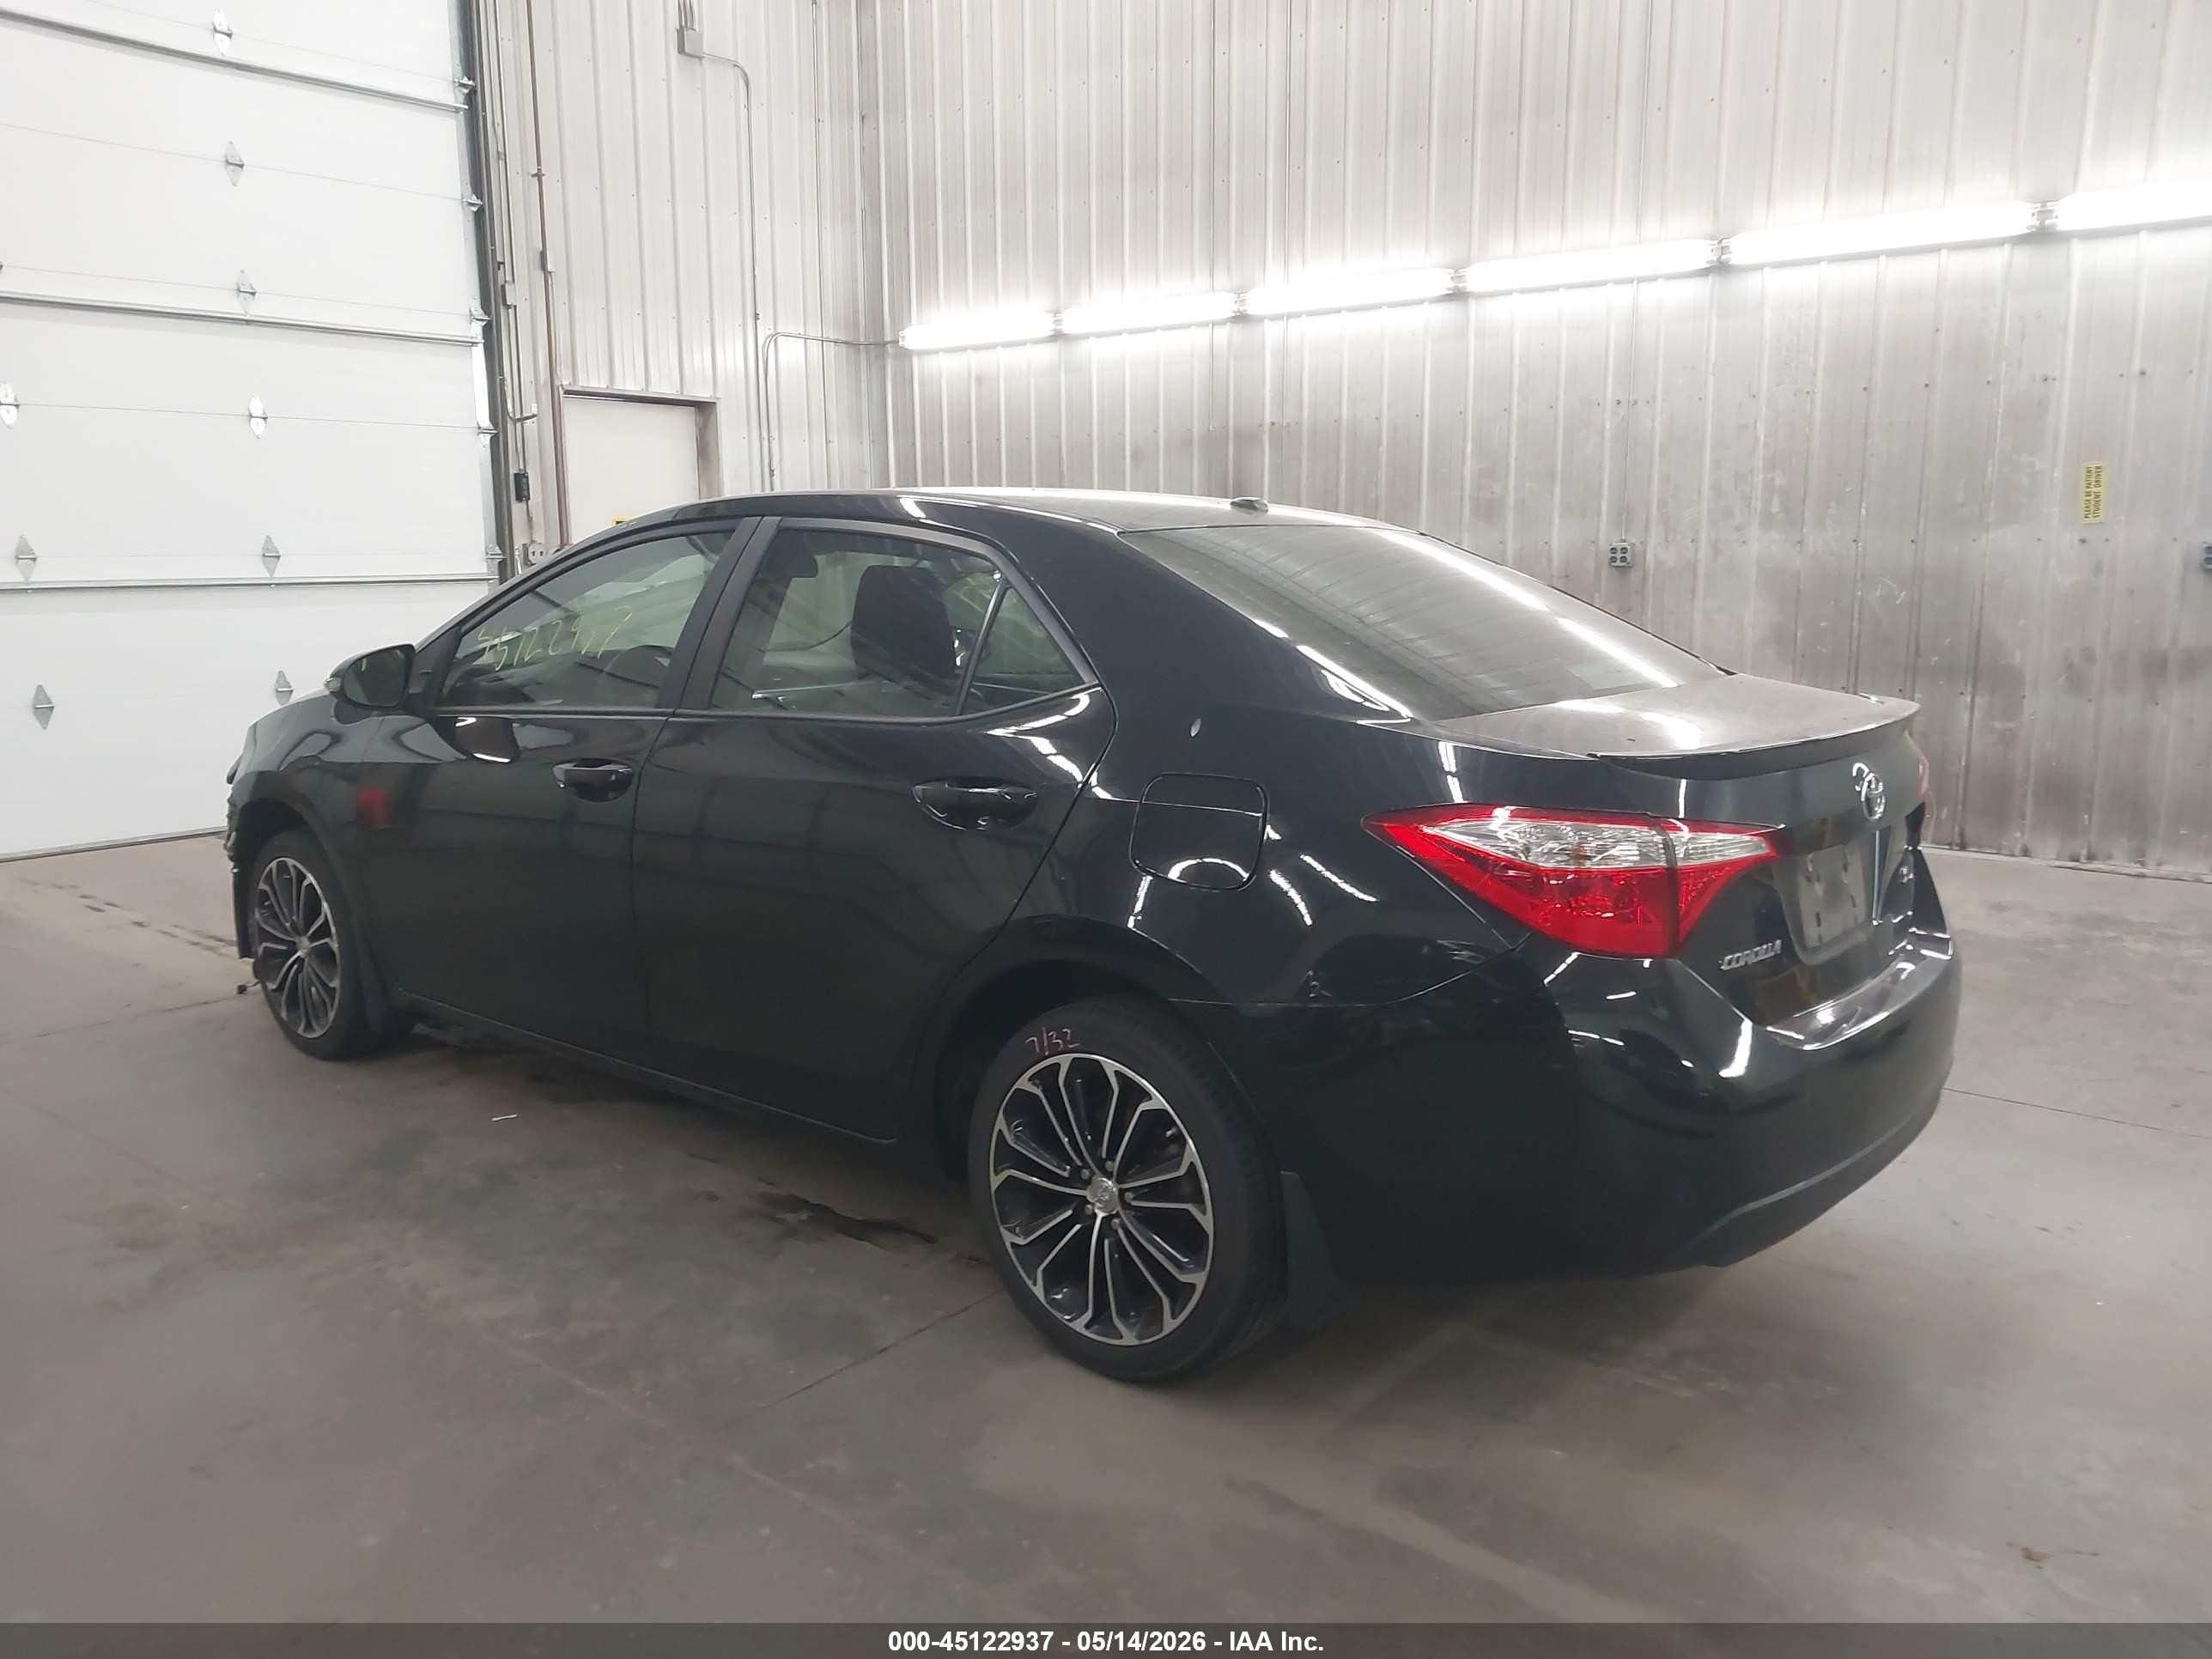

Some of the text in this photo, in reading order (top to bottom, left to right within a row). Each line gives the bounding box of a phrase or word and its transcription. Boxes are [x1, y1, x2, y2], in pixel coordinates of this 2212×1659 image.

[2085, 466, 2094, 489] PATIENT
[2092, 465, 2103, 519] STUDENT DRIVER
[2083, 498, 2092, 520] PLEASE
[1718, 939, 1783, 971] COROLLA
[1024, 1026, 1082, 1056] 7/32
